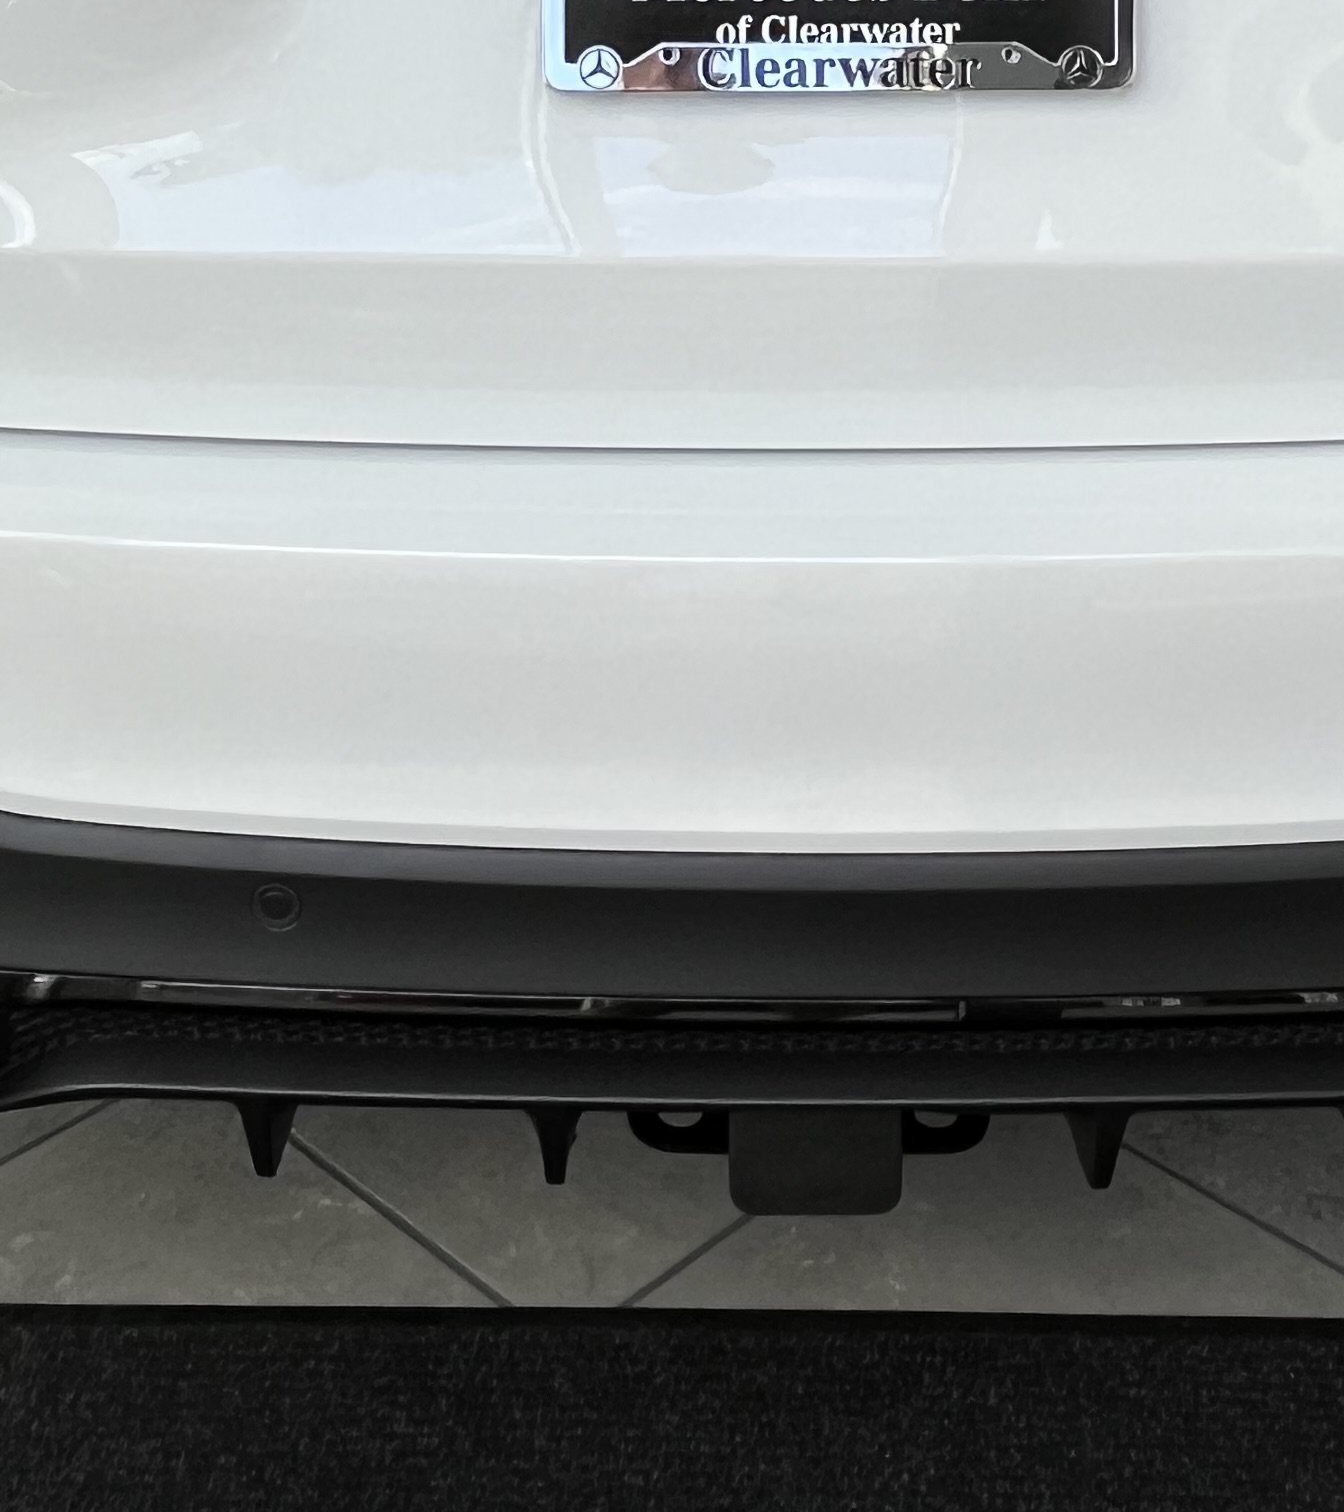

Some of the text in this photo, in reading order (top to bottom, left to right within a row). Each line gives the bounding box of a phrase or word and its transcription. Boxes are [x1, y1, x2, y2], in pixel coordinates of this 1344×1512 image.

[715, 15, 961, 44] of Clearwater
[697, 47, 982, 88] Clearwater
